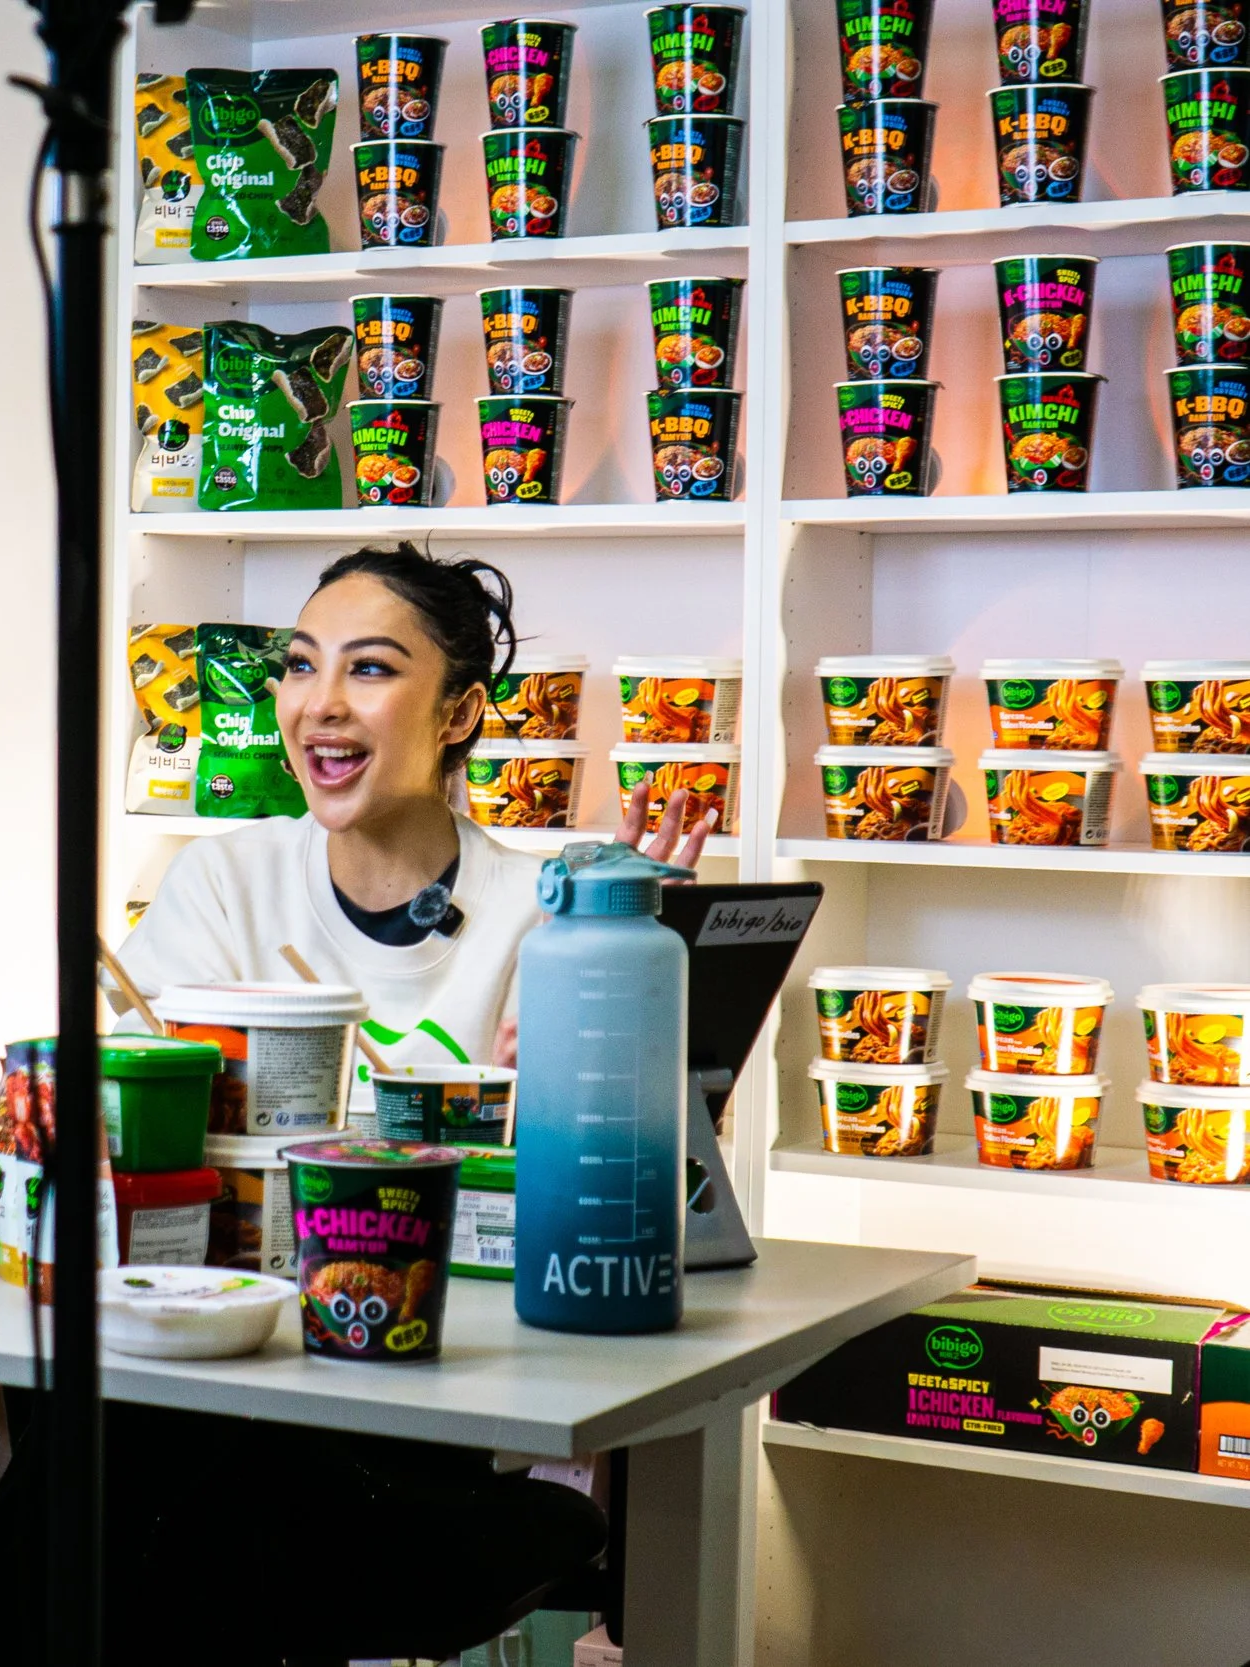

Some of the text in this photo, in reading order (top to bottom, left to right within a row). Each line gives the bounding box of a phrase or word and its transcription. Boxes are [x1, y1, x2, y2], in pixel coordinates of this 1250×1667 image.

[845, 15, 913, 37] KIMCHI
[652, 32, 715, 55] KIMCHI
[361, 60, 420, 81] K-BBQ
[204, 106, 256, 125] bibigo
[1167, 101, 1237, 124] KIMCHI
[999, 113, 1067, 136] K-BBQ
[843, 128, 905, 151] K-BBQ
[206, 152, 244, 171] Chip
[487, 157, 546, 178] KIMCHI
[211, 170, 274, 189] Original
[360, 166, 417, 187] K-BBQ
[1004, 283, 1085, 308] K-CHICKEN
[1173, 273, 1243, 297] KIMCHI
[652, 306, 712, 327] KIMCHI
[846, 295, 910, 318] K-BBQ
[356, 320, 411, 341] K-BBQ
[483, 313, 537, 334] K-BBQ
[218, 404, 255, 423] Chip
[1008, 403, 1079, 424] KIMCHI
[1176, 396, 1245, 419] K-BBQ
[218, 422, 285, 441] Original
[353, 427, 408, 447] KIMCHI
[651, 416, 710, 438] K-BBQ
[214, 712, 250, 731] Chip
[217, 731, 280, 750] Original
[149, 756, 191, 770] 비비고
[381, 1199, 417, 1213] SPICY
[296, 1207, 430, 1247] K-CHICKEN
[543, 1252, 672, 1298] ACTIVE
[931, 1336, 979, 1357] bibigo
